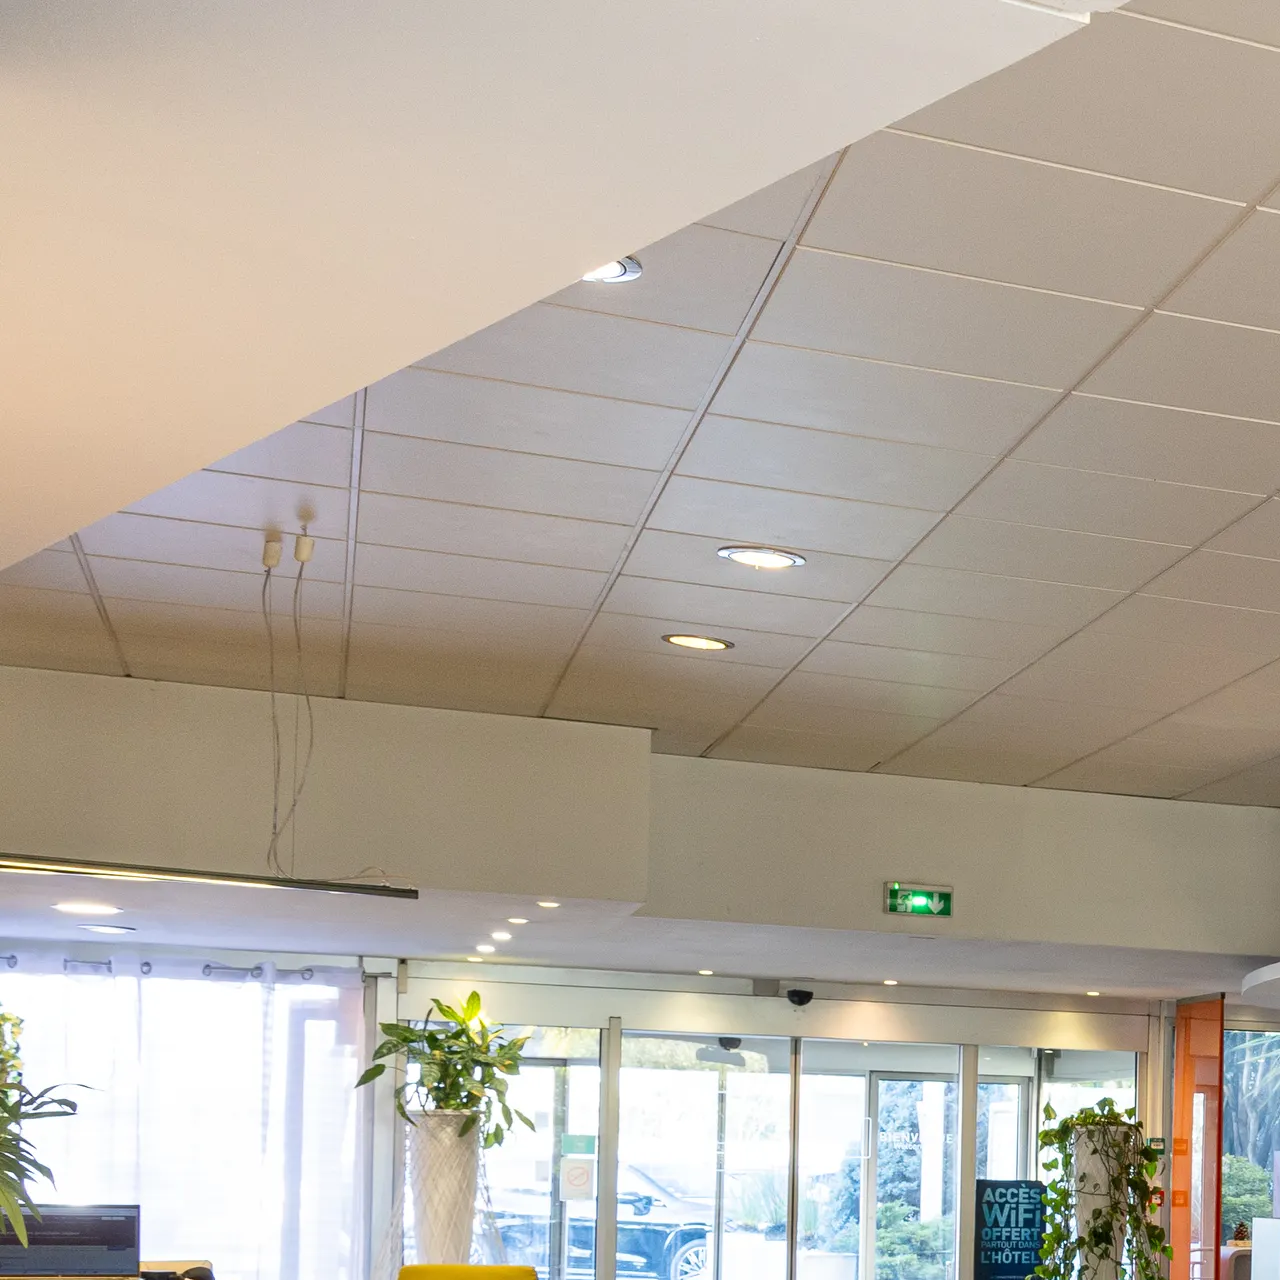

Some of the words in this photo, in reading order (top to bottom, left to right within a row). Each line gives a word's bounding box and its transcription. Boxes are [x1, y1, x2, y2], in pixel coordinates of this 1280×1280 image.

[879, 1131, 954, 1143] BIENVE
[982, 1183, 1040, 1203] ACCÈS
[982, 1203, 1040, 1227] WiFi
[982, 1228, 1040, 1240] OFFERT
[981, 1241, 1017, 1249] PARTOUT
[1018, 1241, 1041, 1249] DANS
[981, 1248, 1040, 1264] L'HÔTEL
